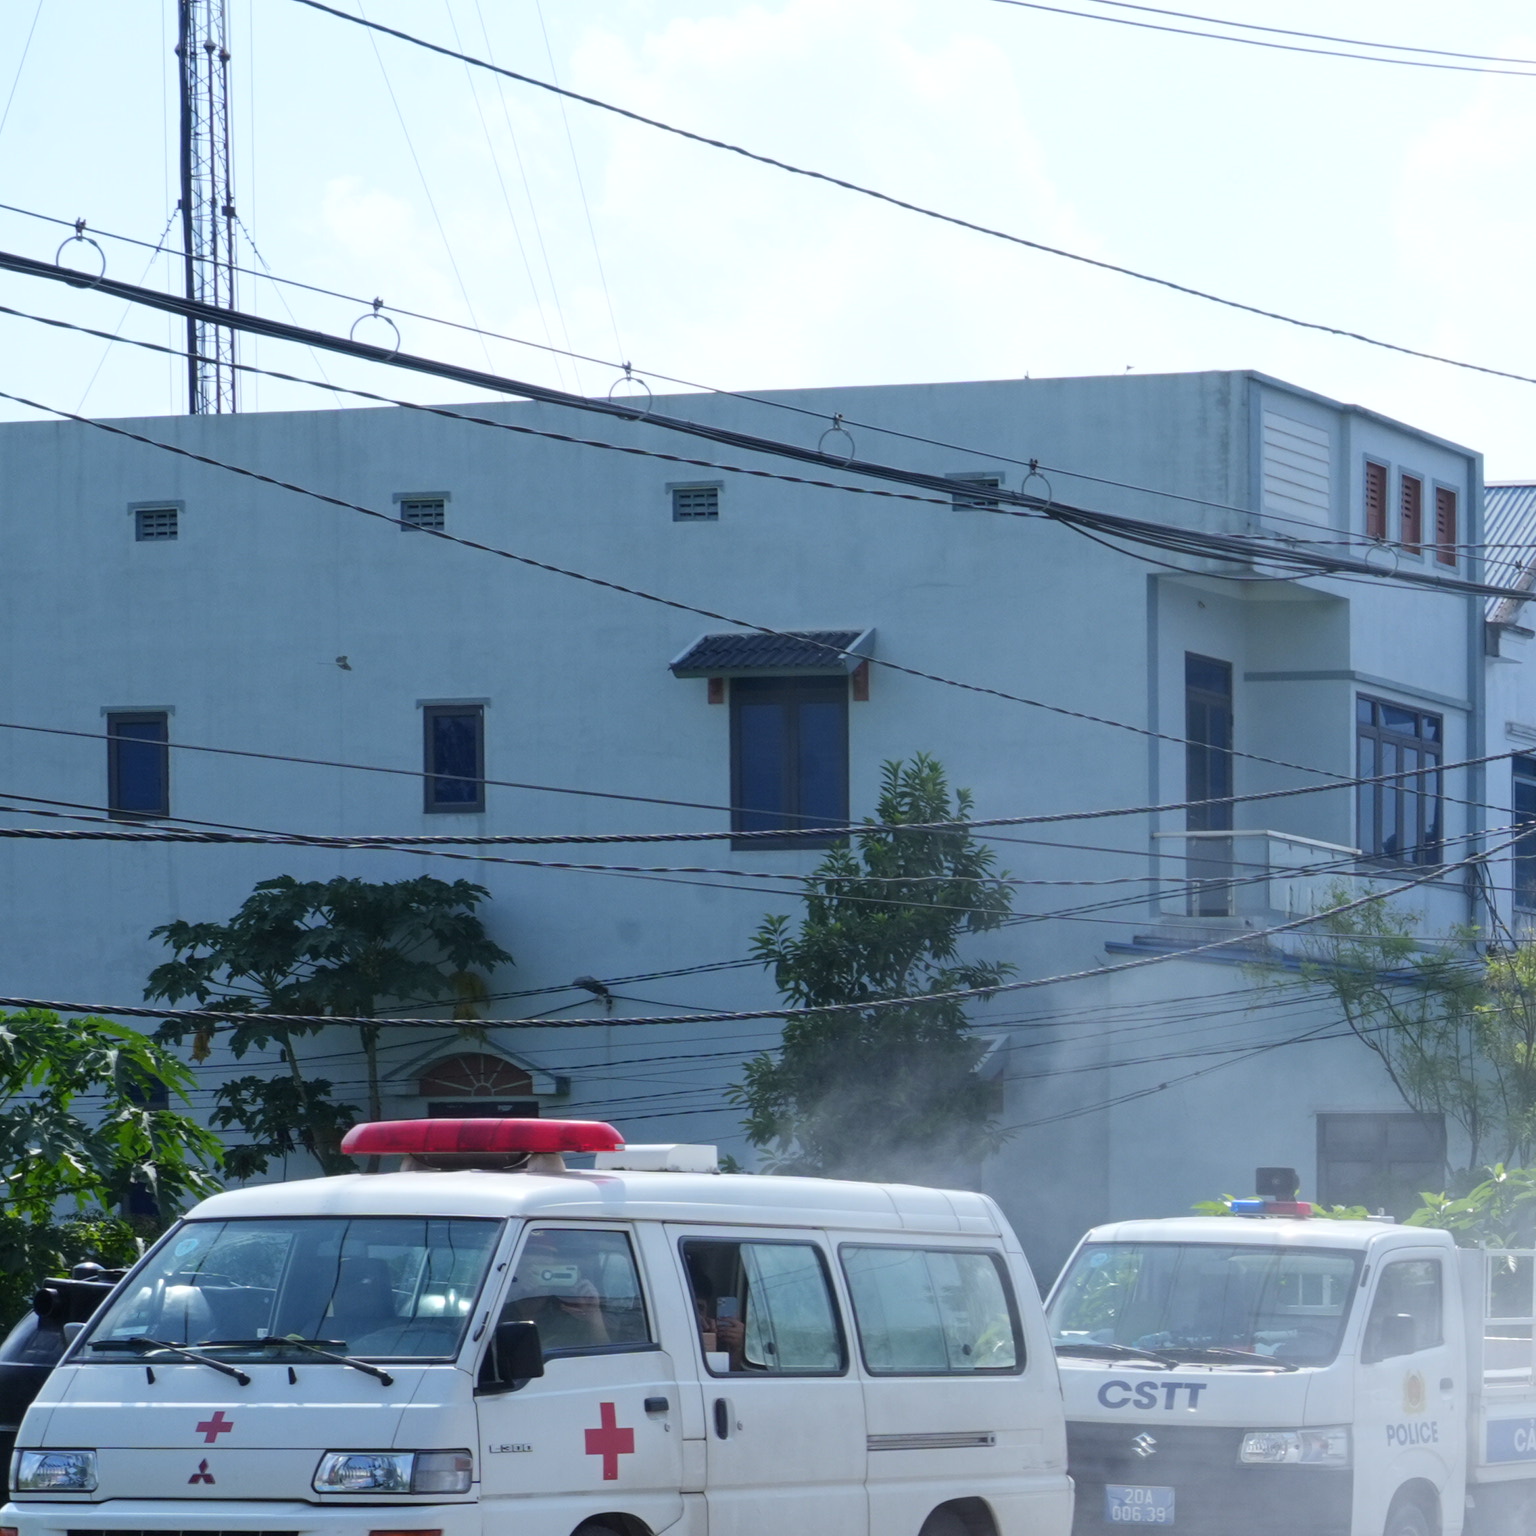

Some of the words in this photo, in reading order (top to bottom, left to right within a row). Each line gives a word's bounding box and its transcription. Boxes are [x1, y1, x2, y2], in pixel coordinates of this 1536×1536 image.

[1097, 1380, 1208, 1410] CSTT
[1385, 1421, 1439, 1447] POLICE
[1124, 1488, 1153, 1504] 20A
[1111, 1505, 1166, 1522] 006.39
